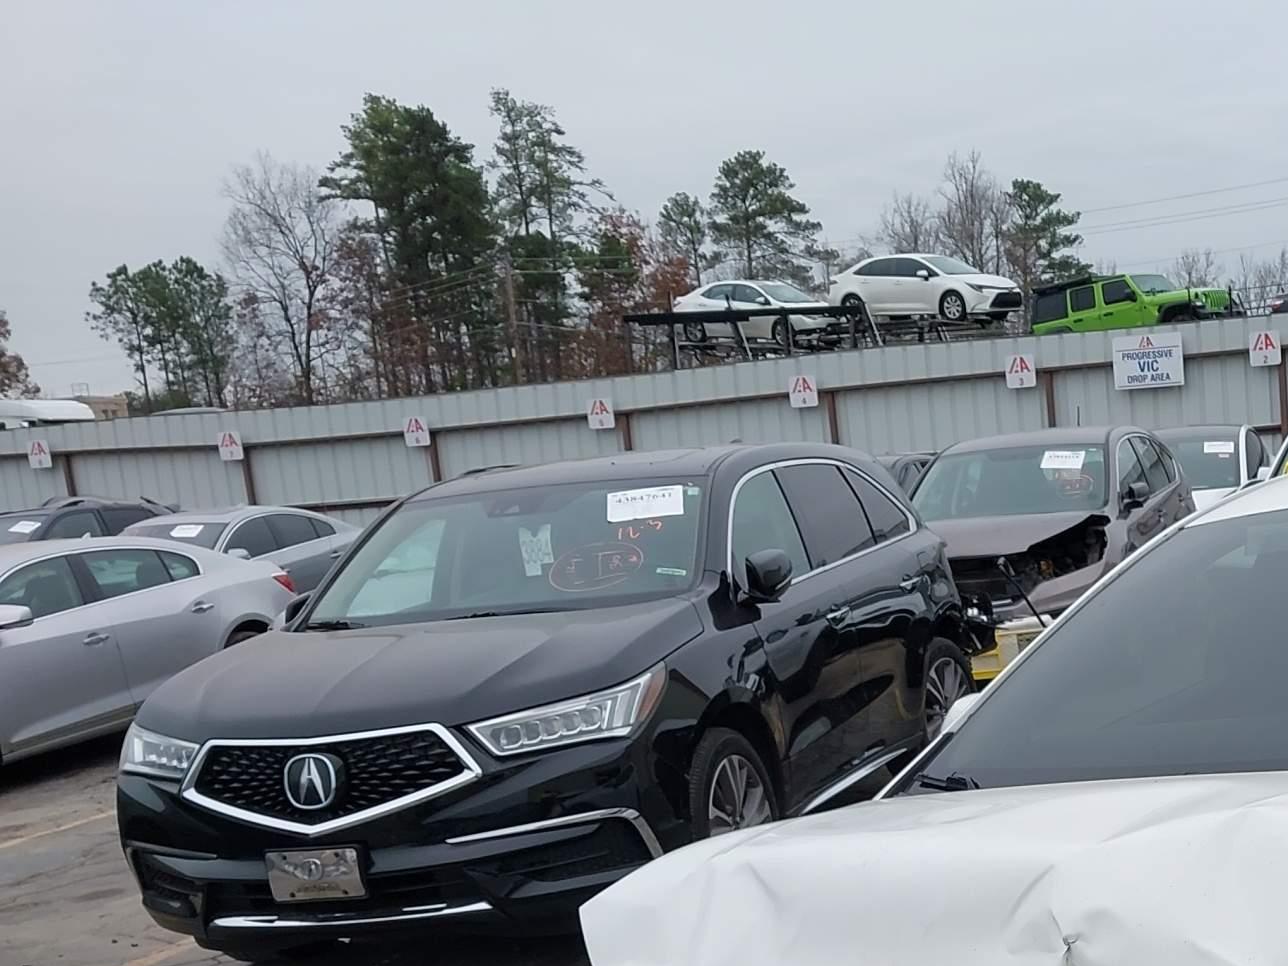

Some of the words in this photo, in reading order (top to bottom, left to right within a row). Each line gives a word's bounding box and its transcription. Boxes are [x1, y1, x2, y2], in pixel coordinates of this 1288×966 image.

[1121, 349, 1174, 360] PROGRESSIVE
[1263, 355, 1269, 364] 2
[1138, 359, 1160, 372] VIC
[1127, 374, 1148, 384] DROP
[1150, 372, 1171, 382] AREA
